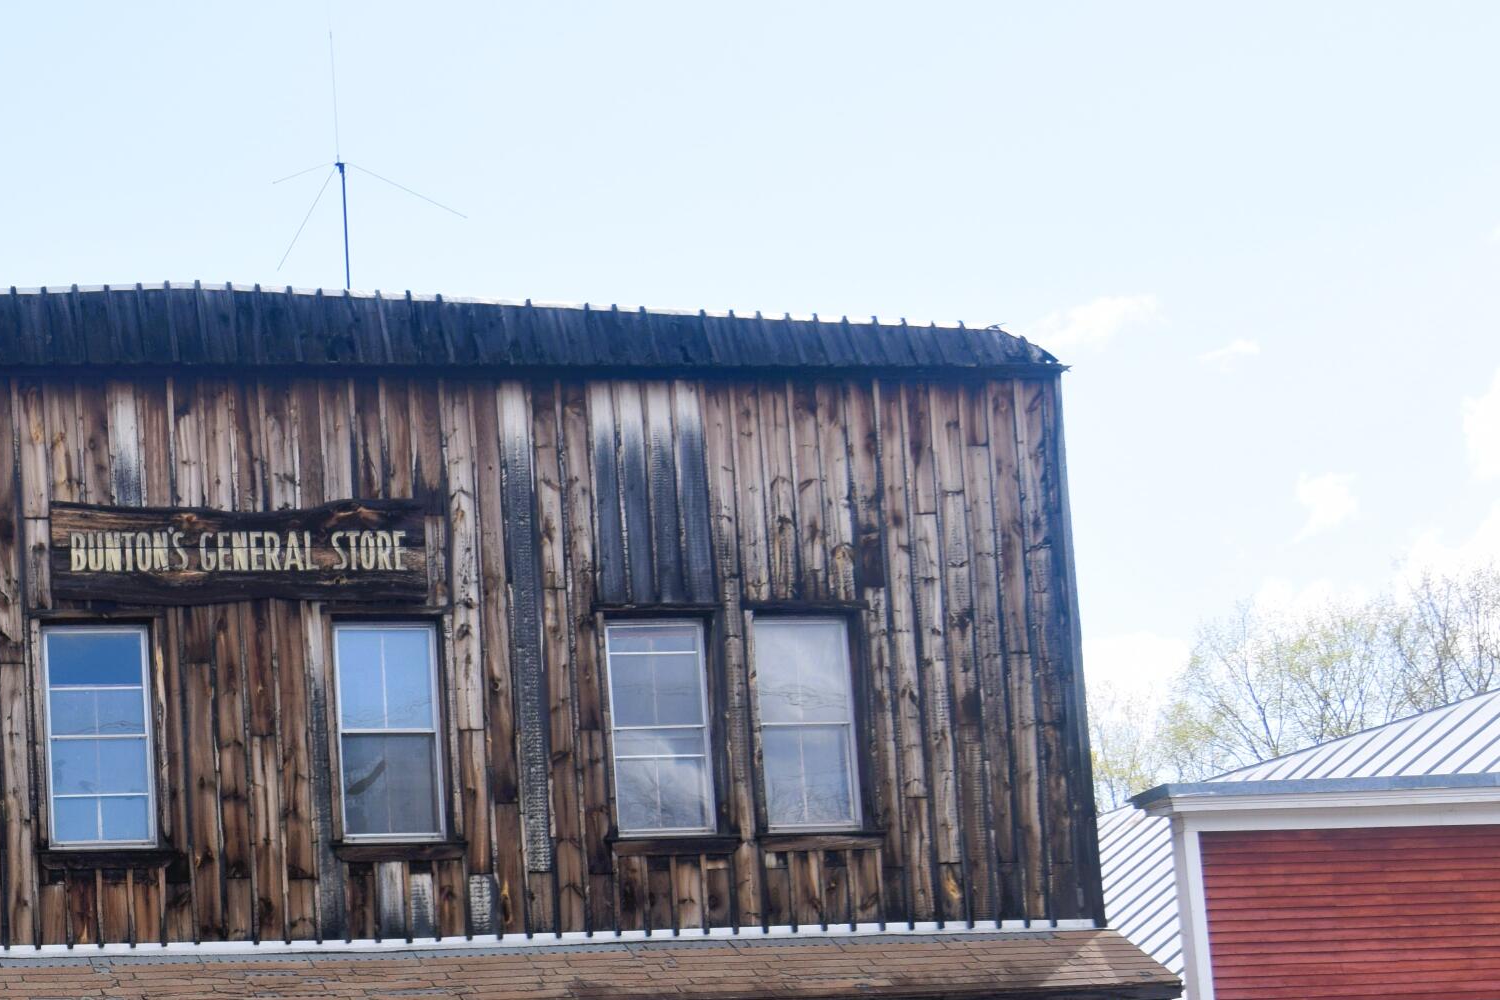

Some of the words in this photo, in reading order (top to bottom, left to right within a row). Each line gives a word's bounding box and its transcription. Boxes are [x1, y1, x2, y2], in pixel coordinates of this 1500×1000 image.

[70, 526, 189, 572] BUNTON'S
[199, 530, 320, 571] GENERAL
[330, 529, 409, 571] STORE
